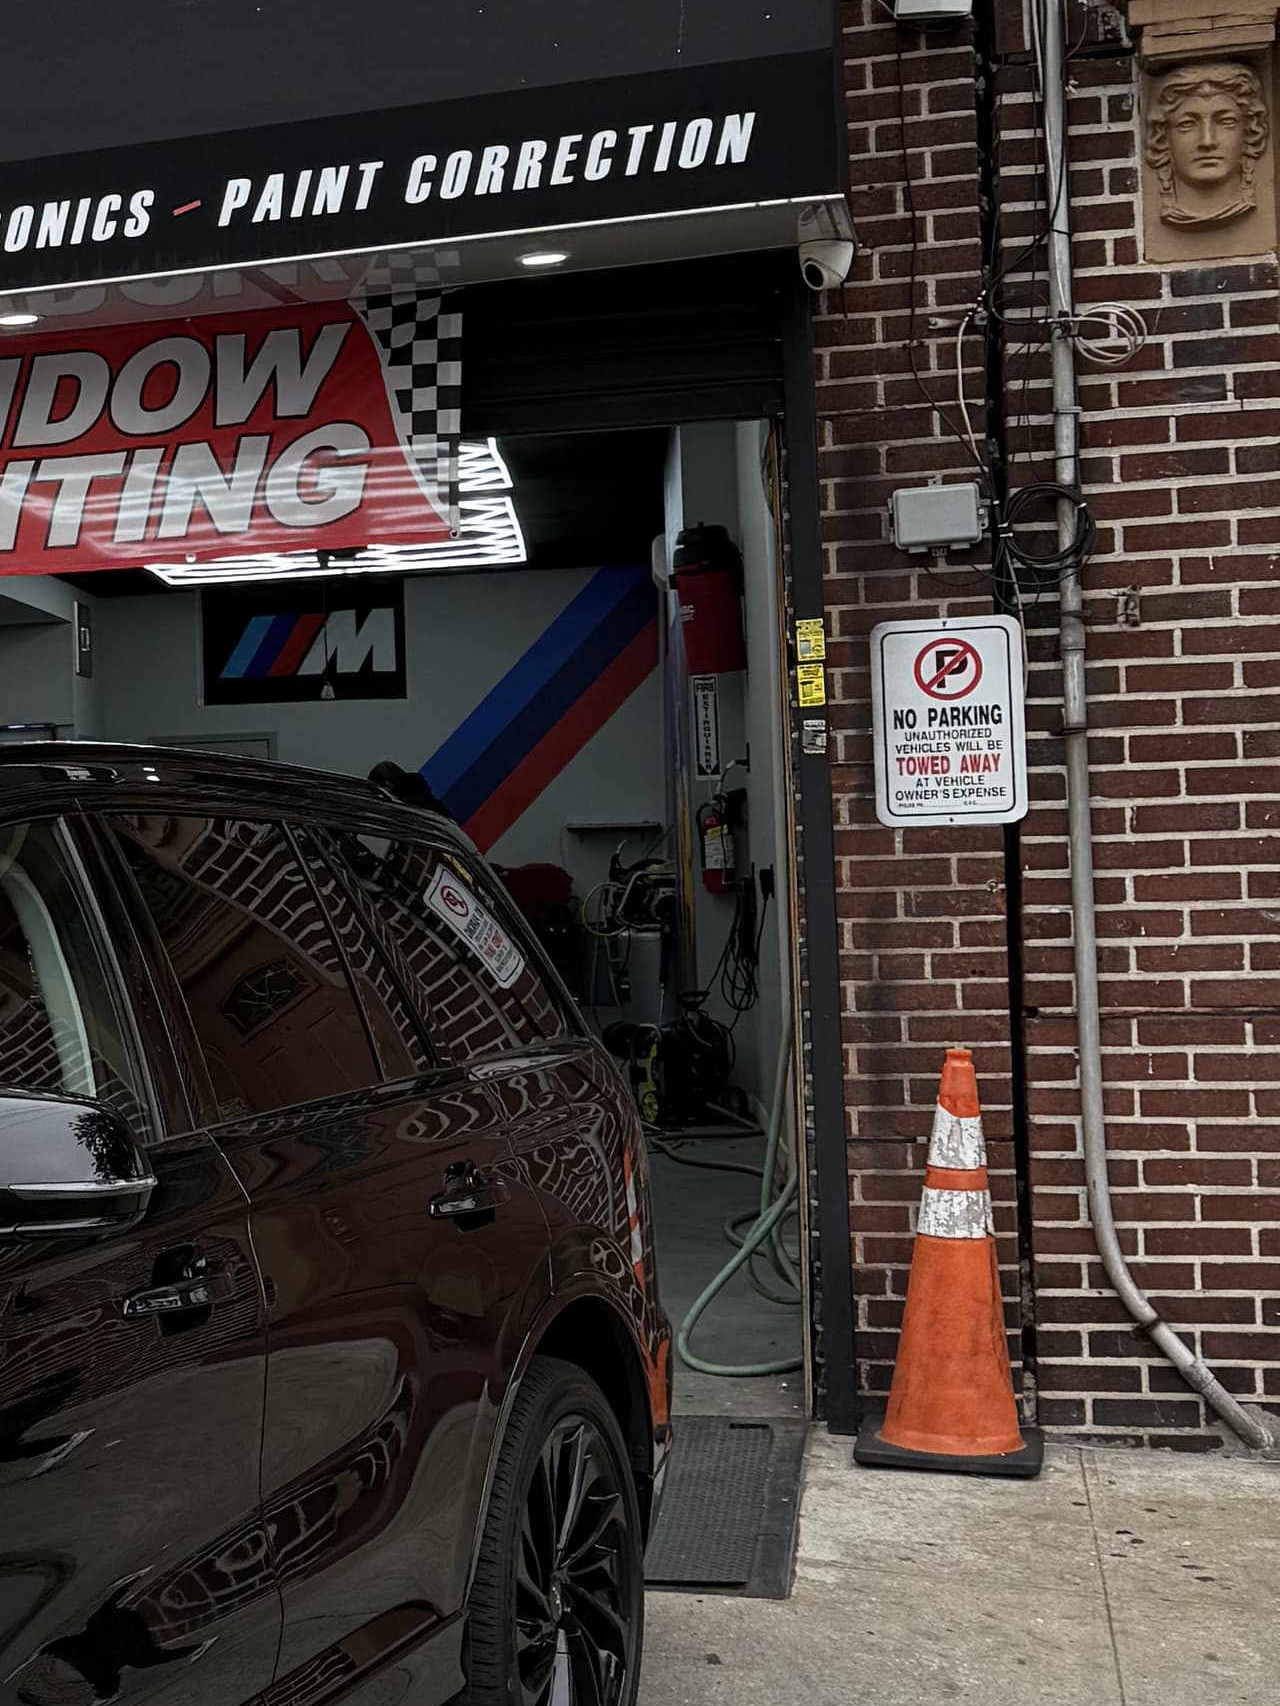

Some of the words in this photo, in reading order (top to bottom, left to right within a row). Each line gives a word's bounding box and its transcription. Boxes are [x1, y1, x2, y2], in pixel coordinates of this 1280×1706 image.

[217, 160, 385, 228] PAINT
[405, 111, 758, 206] CORRECTION
[893, 709, 917, 729] NO
[928, 704, 1002, 727] PARKING
[904, 728, 992, 742] UNAUTHORIZED
[895, 742, 951, 754] VEHICLES
[956, 741, 983, 752] WILL
[987, 740, 1003, 750] BE
[895, 756, 951, 777] TOWED
[960, 753, 1001, 774] AWAY
[916, 777, 929, 788] AT
[935, 775, 985, 787] VEHICLE
[895, 788, 951, 801] OWNER'S
[953, 786, 1007, 798] EXPENSE
